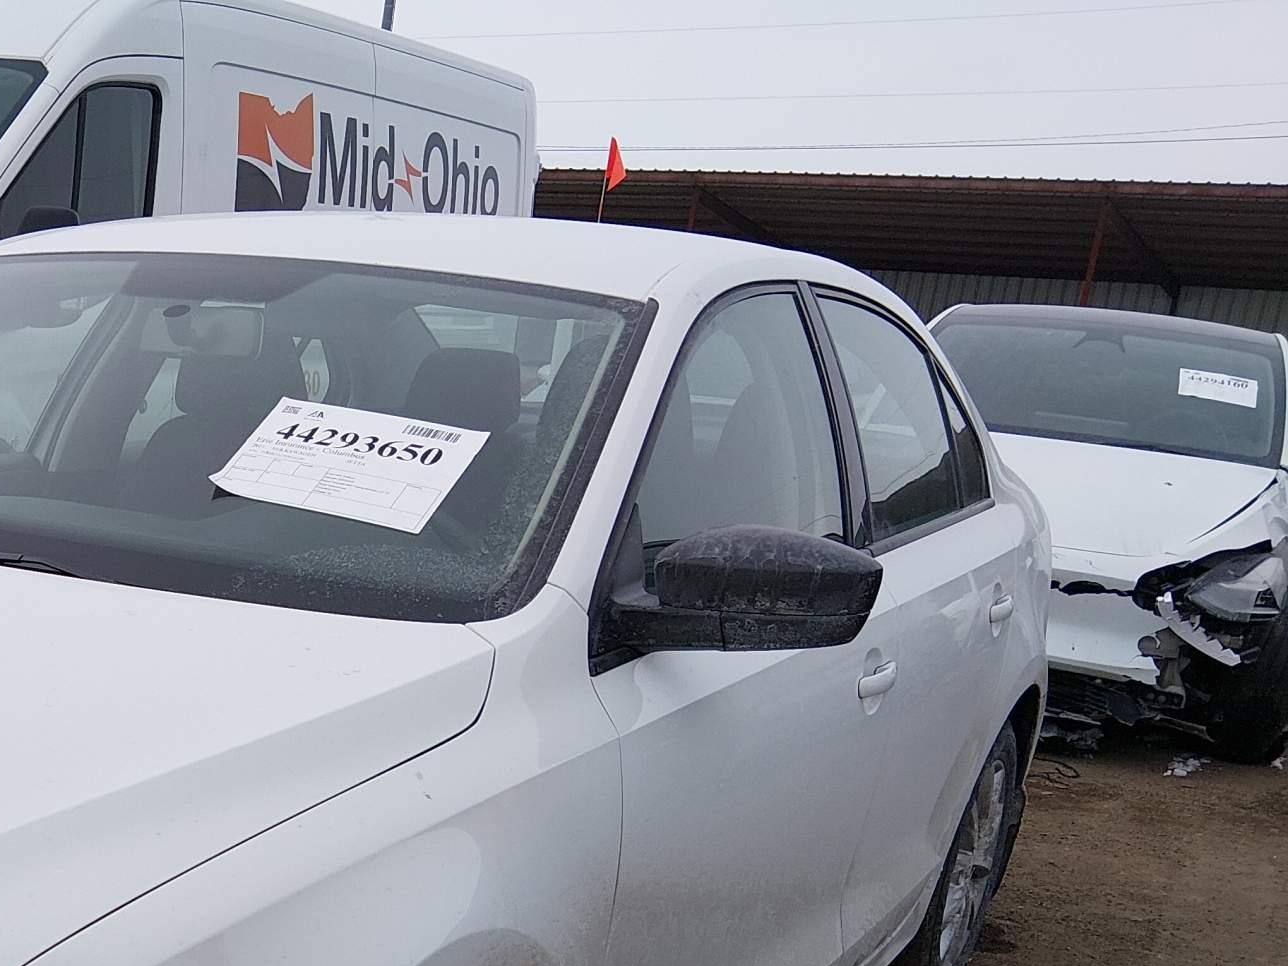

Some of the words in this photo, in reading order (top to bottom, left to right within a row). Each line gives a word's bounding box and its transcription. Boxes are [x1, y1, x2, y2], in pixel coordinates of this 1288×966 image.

[1187, 375, 1249, 390] 44294160
[275, 423, 444, 466] 44293650
[322, 447, 365, 460] Columbus
